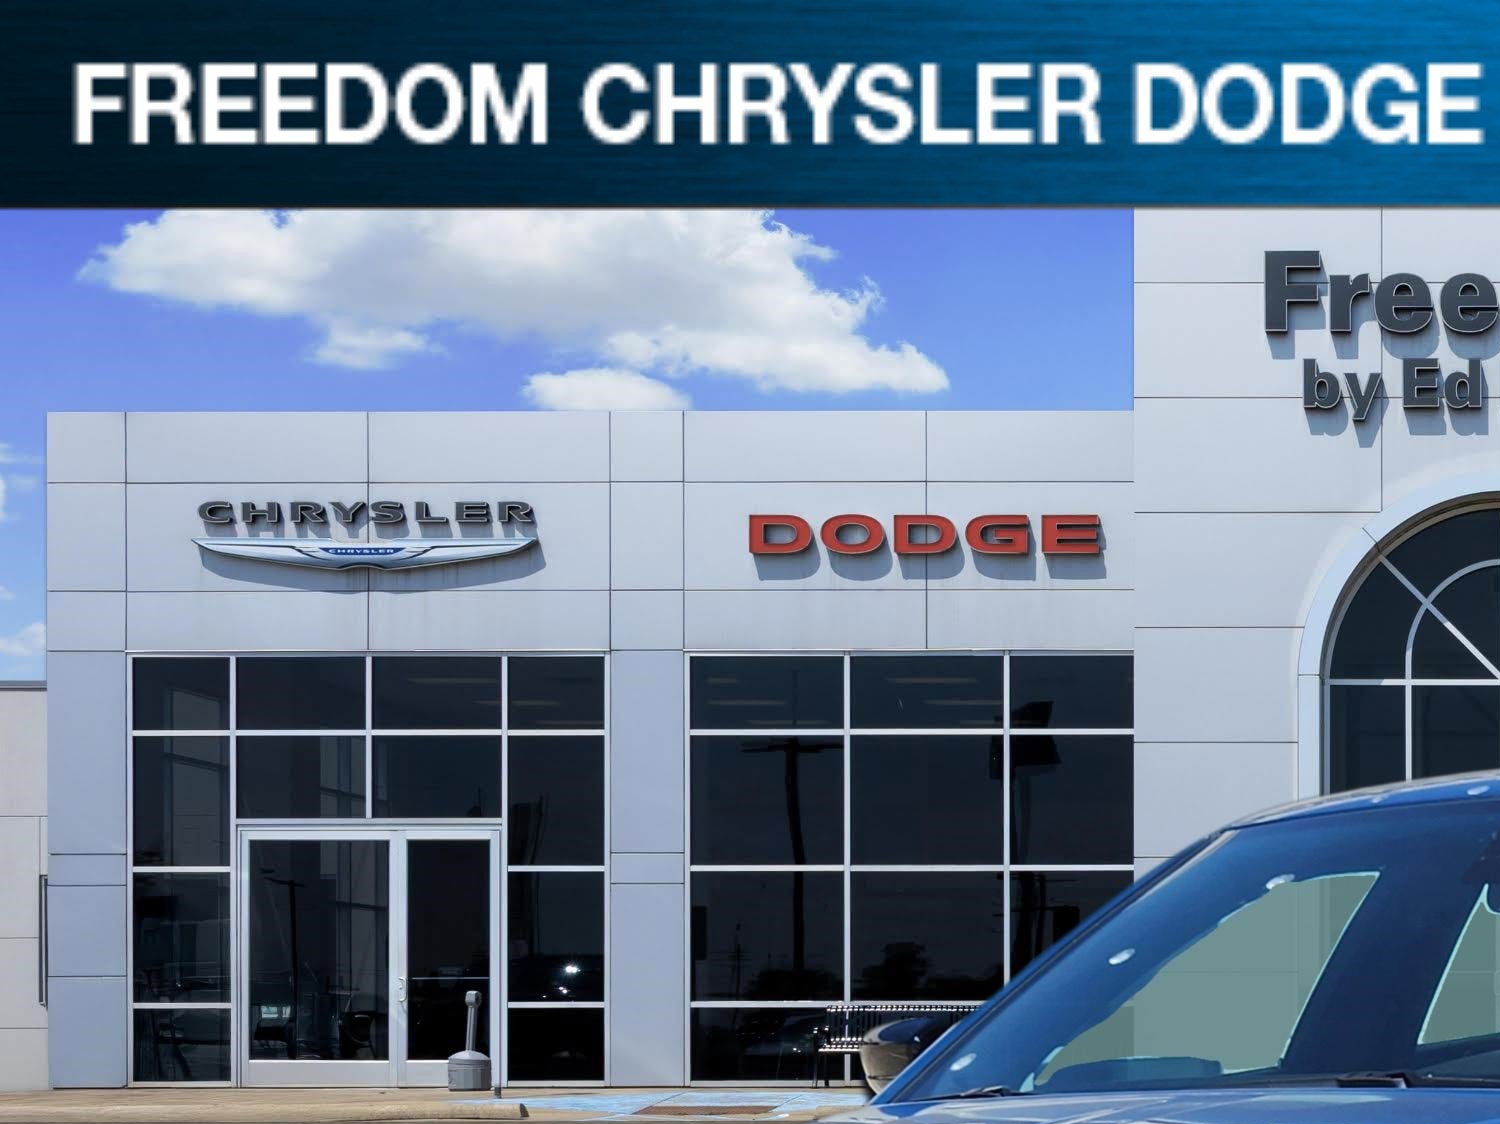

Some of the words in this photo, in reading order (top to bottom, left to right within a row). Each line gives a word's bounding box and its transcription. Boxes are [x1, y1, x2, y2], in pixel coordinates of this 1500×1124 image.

[1303, 358, 1382, 422] by
[1402, 358, 1483, 409] Ed
[198, 501, 535, 524] CHRYSLER
[749, 514, 1100, 555] DODGE
